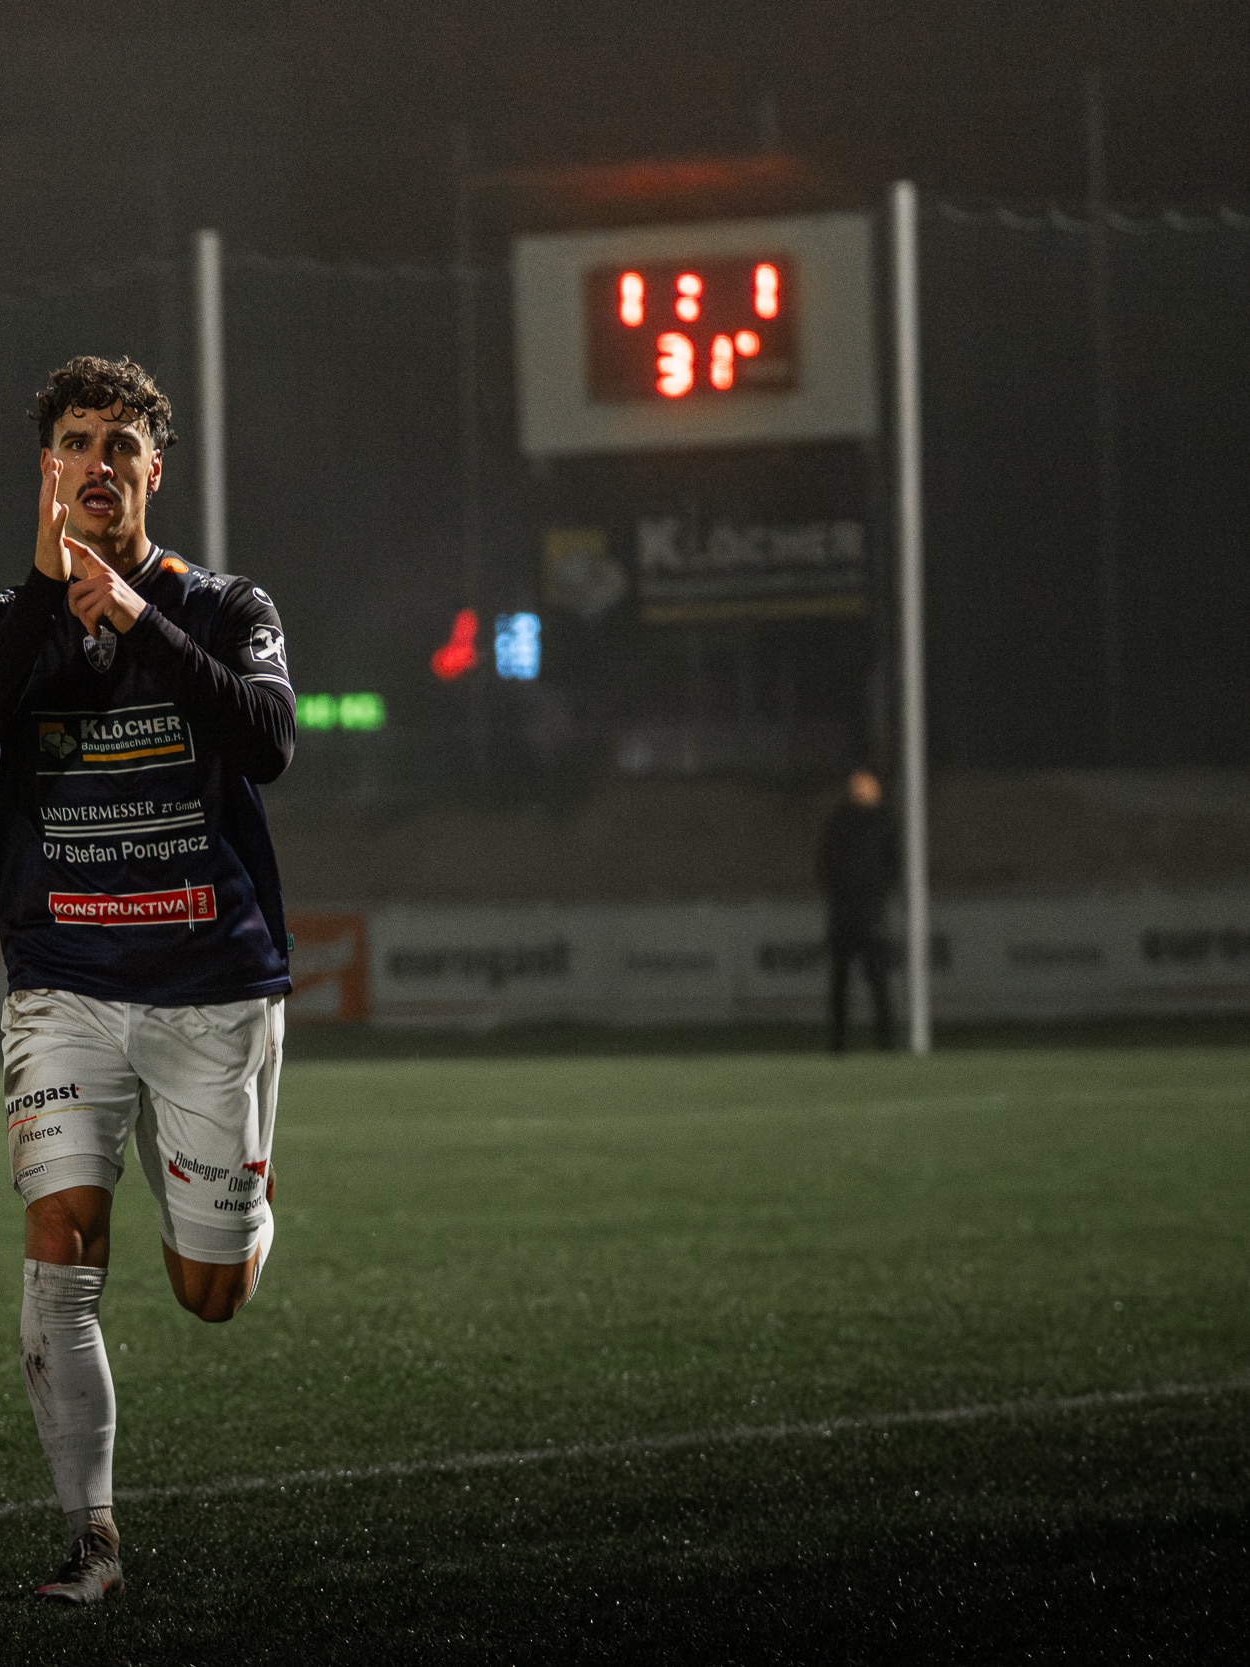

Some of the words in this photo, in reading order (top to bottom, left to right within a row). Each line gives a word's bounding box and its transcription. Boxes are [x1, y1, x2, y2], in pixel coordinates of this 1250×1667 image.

[79, 715, 182, 741] KLÖCHER
[40, 800, 156, 822] LANDVERMESSER
[161, 802, 174, 814] ZT
[175, 799, 202, 811] GmbH
[43, 842, 61, 860] DI
[65, 843, 118, 864] Stefan
[121, 835, 209, 861] Pongracz
[53, 898, 187, 917] KONSTRUKTIVA
[197, 891, 208, 915] BAU
[6, 1083, 80, 1117] urogast
[18, 1125, 63, 1145] Interex
[174, 1150, 230, 1183] Hochegger
[214, 1195, 262, 1214] uhlsport
